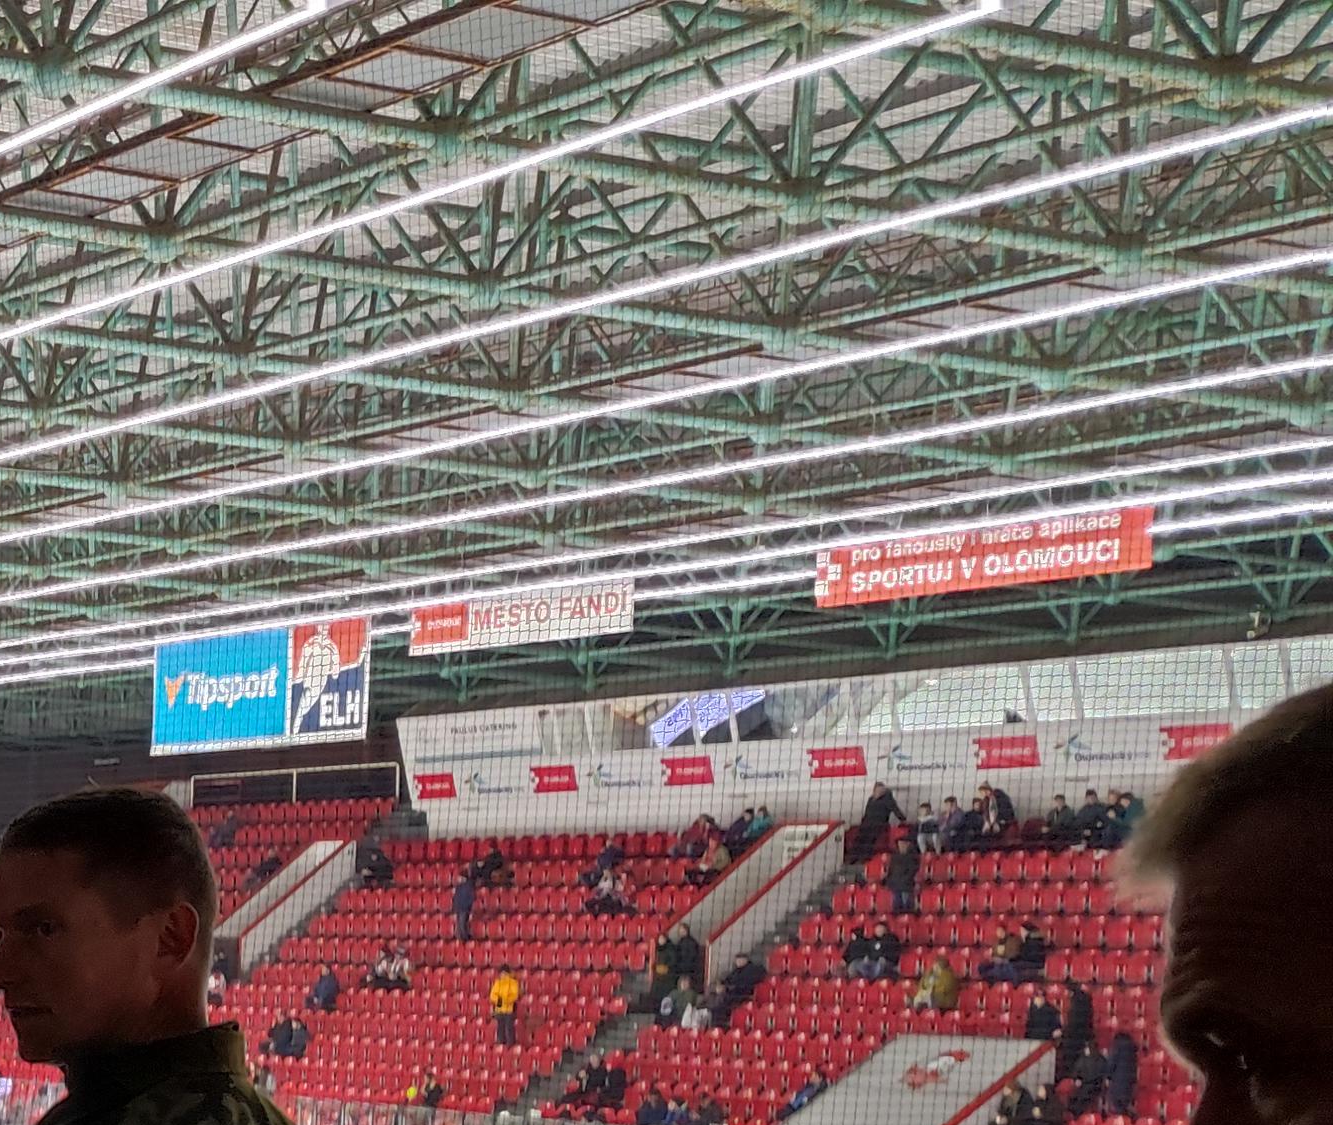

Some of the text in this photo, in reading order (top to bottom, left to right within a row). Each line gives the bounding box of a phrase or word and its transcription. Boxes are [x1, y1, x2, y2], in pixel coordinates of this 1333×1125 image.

[852, 547, 881, 566] pro
[1039, 513, 1122, 539] aplikace
[852, 538, 1121, 593] SPORTUJ V OLOMOUCI
[187, 665, 280, 711] Tipsport
[320, 690, 360, 727] ELH
